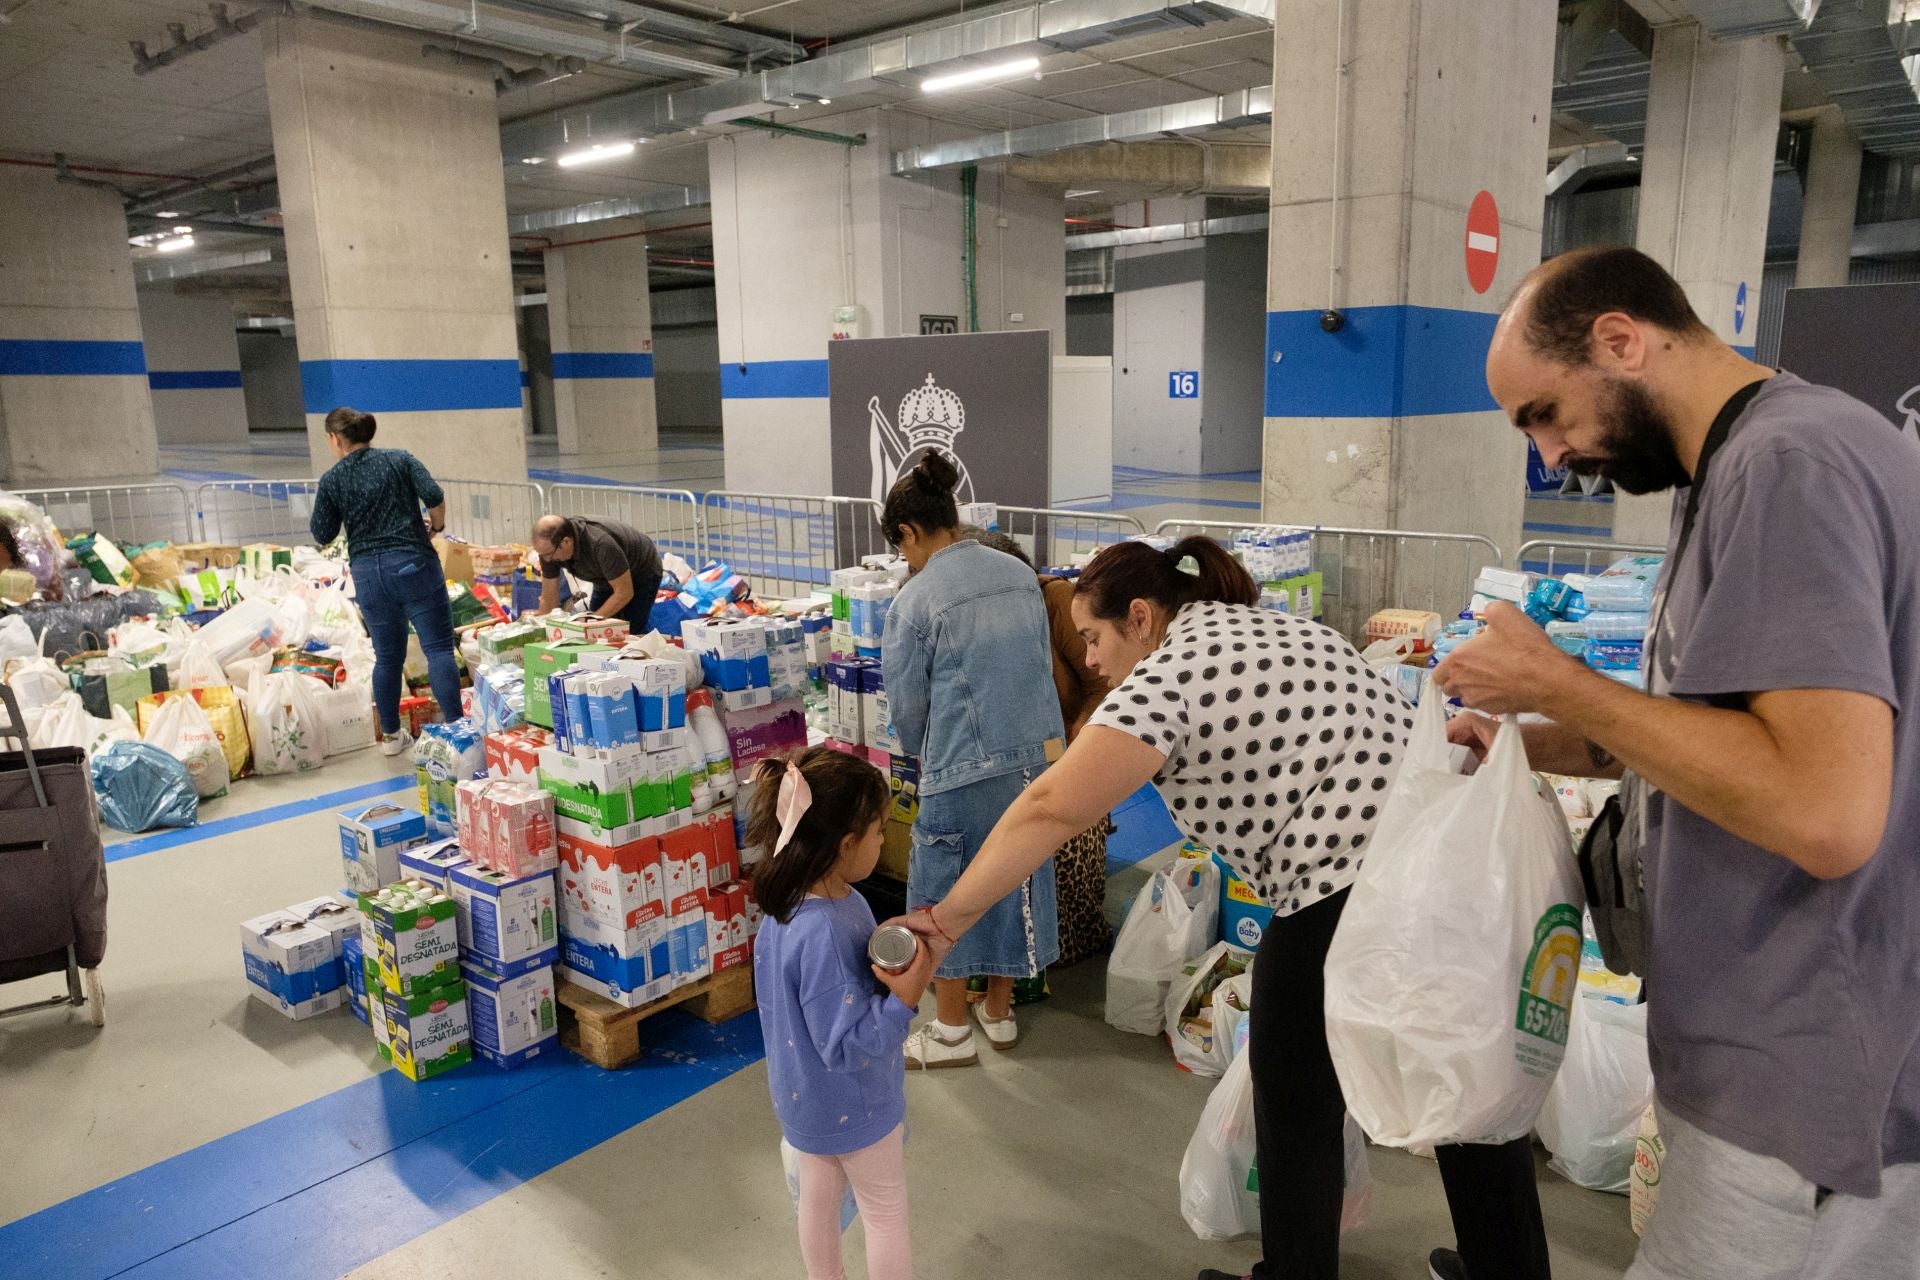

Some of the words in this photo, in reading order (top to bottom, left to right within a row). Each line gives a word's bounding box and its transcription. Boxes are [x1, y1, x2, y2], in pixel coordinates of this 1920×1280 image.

[1172, 374, 1195, 395] 16
[736, 736, 752, 750] Sin
[737, 744, 766, 758] Lactosa
[591, 883, 613, 897] ENTERA
[1234, 885, 1257, 900] MEG
[635, 911, 657, 926] ENTERA
[1239, 926, 1260, 940] Baby
[414, 936, 442, 951] SEMI
[400, 942, 457, 965] DESNATADA
[566, 950, 595, 972] ENTERA
[247, 964, 269, 985] ENTERA
[428, 1018, 454, 1035] SEMI
[415, 1023, 469, 1050] DESNATADA
